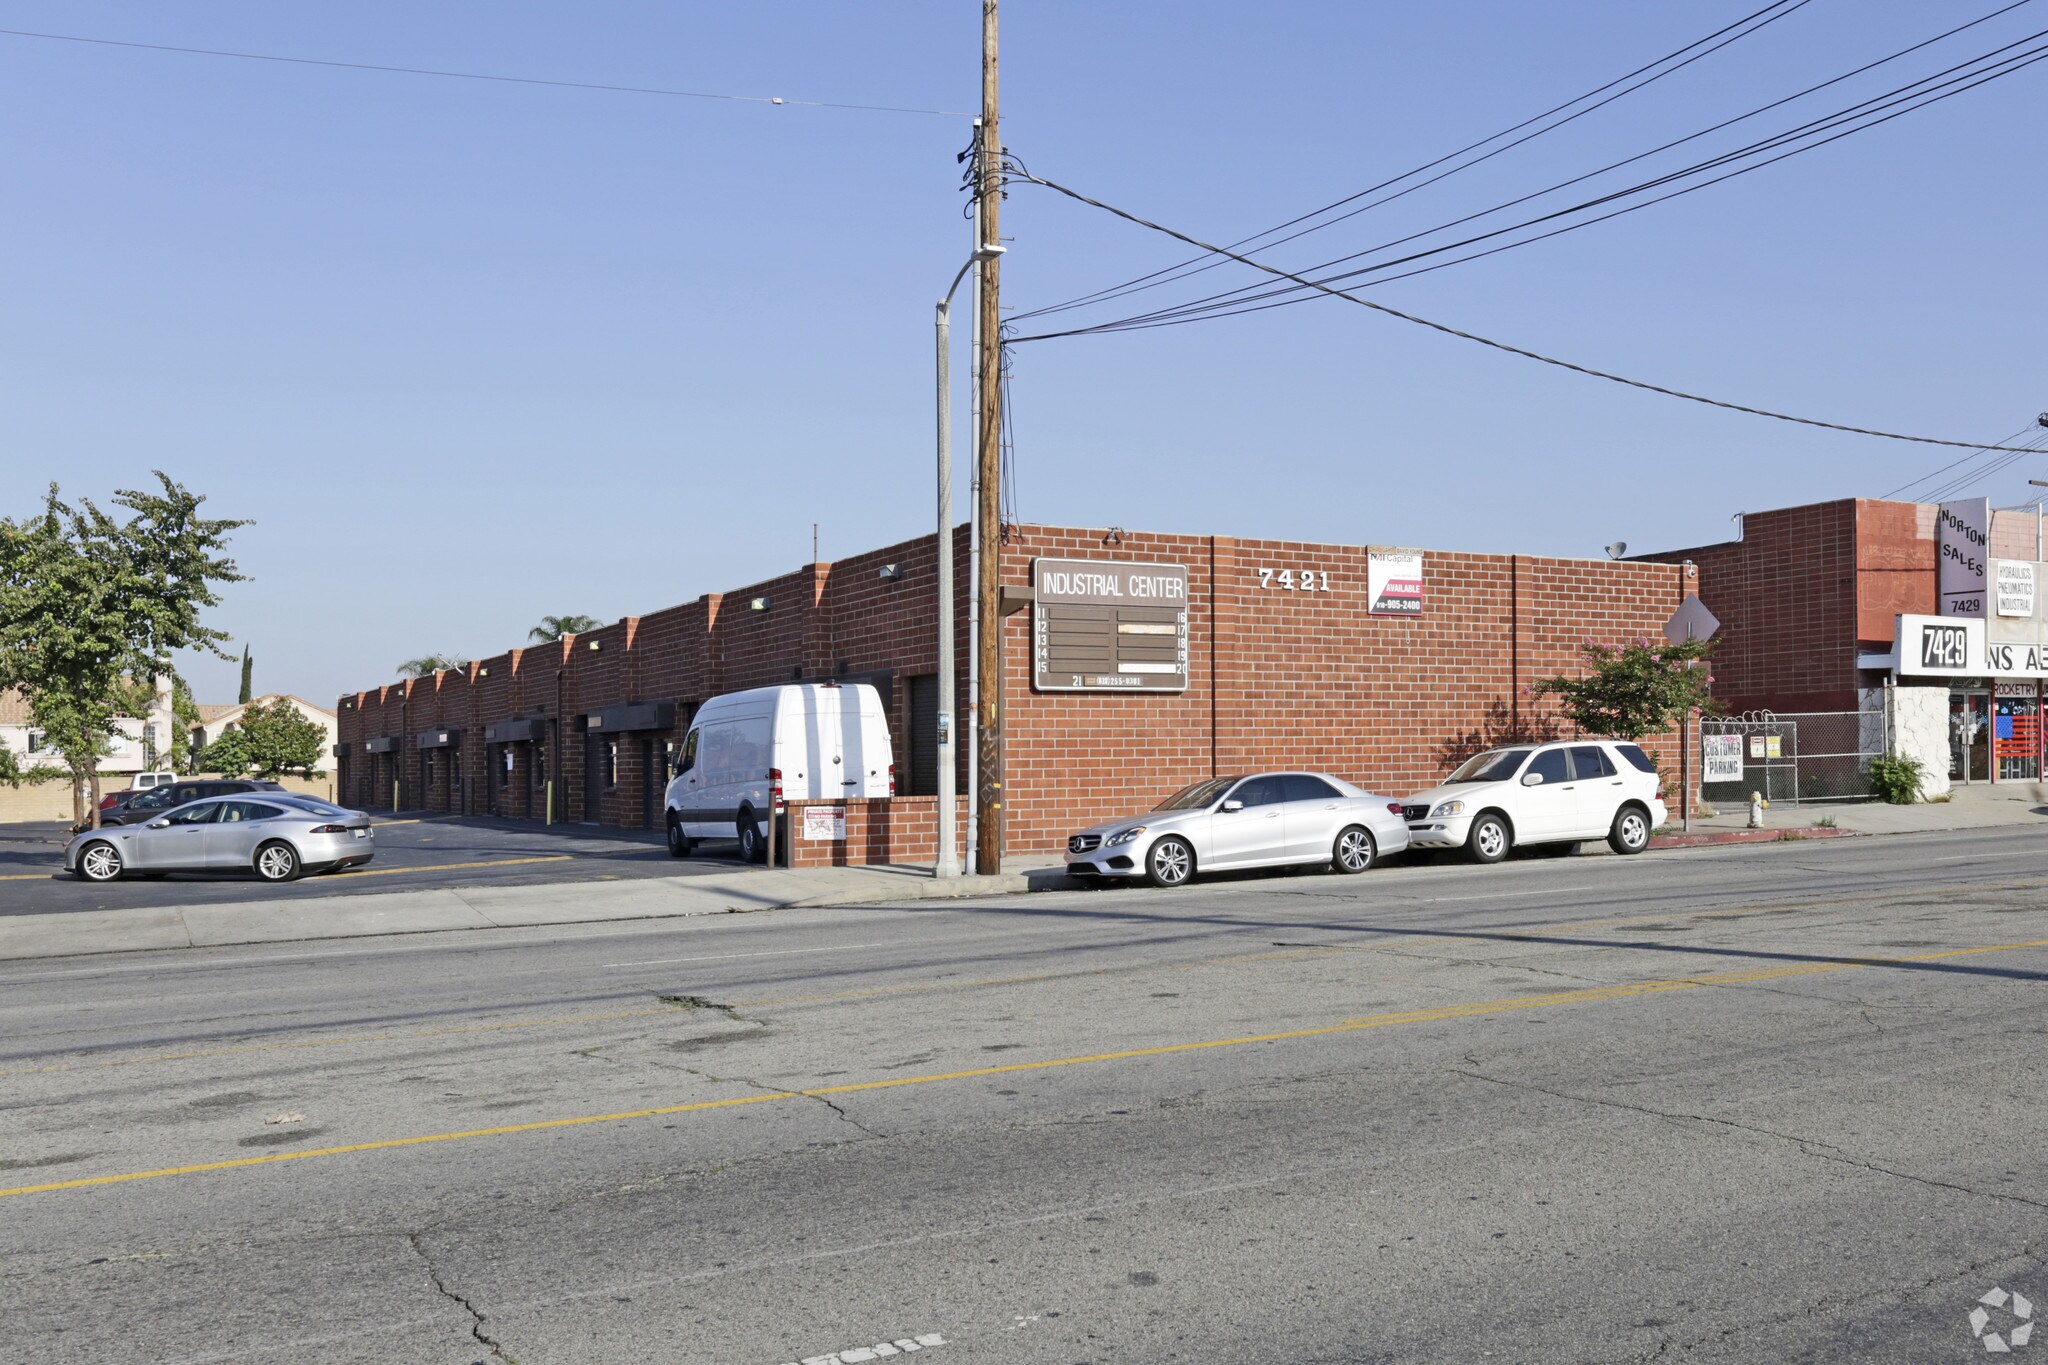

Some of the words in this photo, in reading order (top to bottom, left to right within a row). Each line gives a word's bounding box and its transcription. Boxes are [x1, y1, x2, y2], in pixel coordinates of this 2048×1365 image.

[1942, 509, 1986, 546] NORTON
[1387, 554, 1413, 563] Capital
[1943, 544, 1983, 577] SALES
[1999, 565, 2032, 579] HYDRAULICS
[1258, 567, 1330, 591] 7421
[1043, 572, 1123, 596] INDUSTRIAL
[1129, 575, 1184, 599] CENTER
[1386, 583, 1421, 594] AVAILABLE
[1997, 582, 2033, 596] PNEUMATICS
[1376, 599, 1421, 610] 818-905-2400
[1951, 599, 1980, 613] 7429
[2000, 598, 2031, 611] INDUSTRIAL
[1038, 608, 1045, 619] 11
[1177, 612, 1186, 623] 16
[1038, 621, 1047, 633] 12
[1177, 625, 1186, 636] 17
[1038, 635, 1047, 646] 13
[1177, 638, 1186, 649] 18
[1924, 629, 1966, 665] 7429
[1038, 648, 1048, 659] 14
[1177, 650, 1186, 661] 19
[1038, 661, 1047, 673] 15
[1072, 675, 1082, 687] 21
[1994, 683, 2037, 696] ROCKETRY
[1705, 742, 1741, 756] CUSTOMER
[1709, 761, 1738, 775] PARKING
